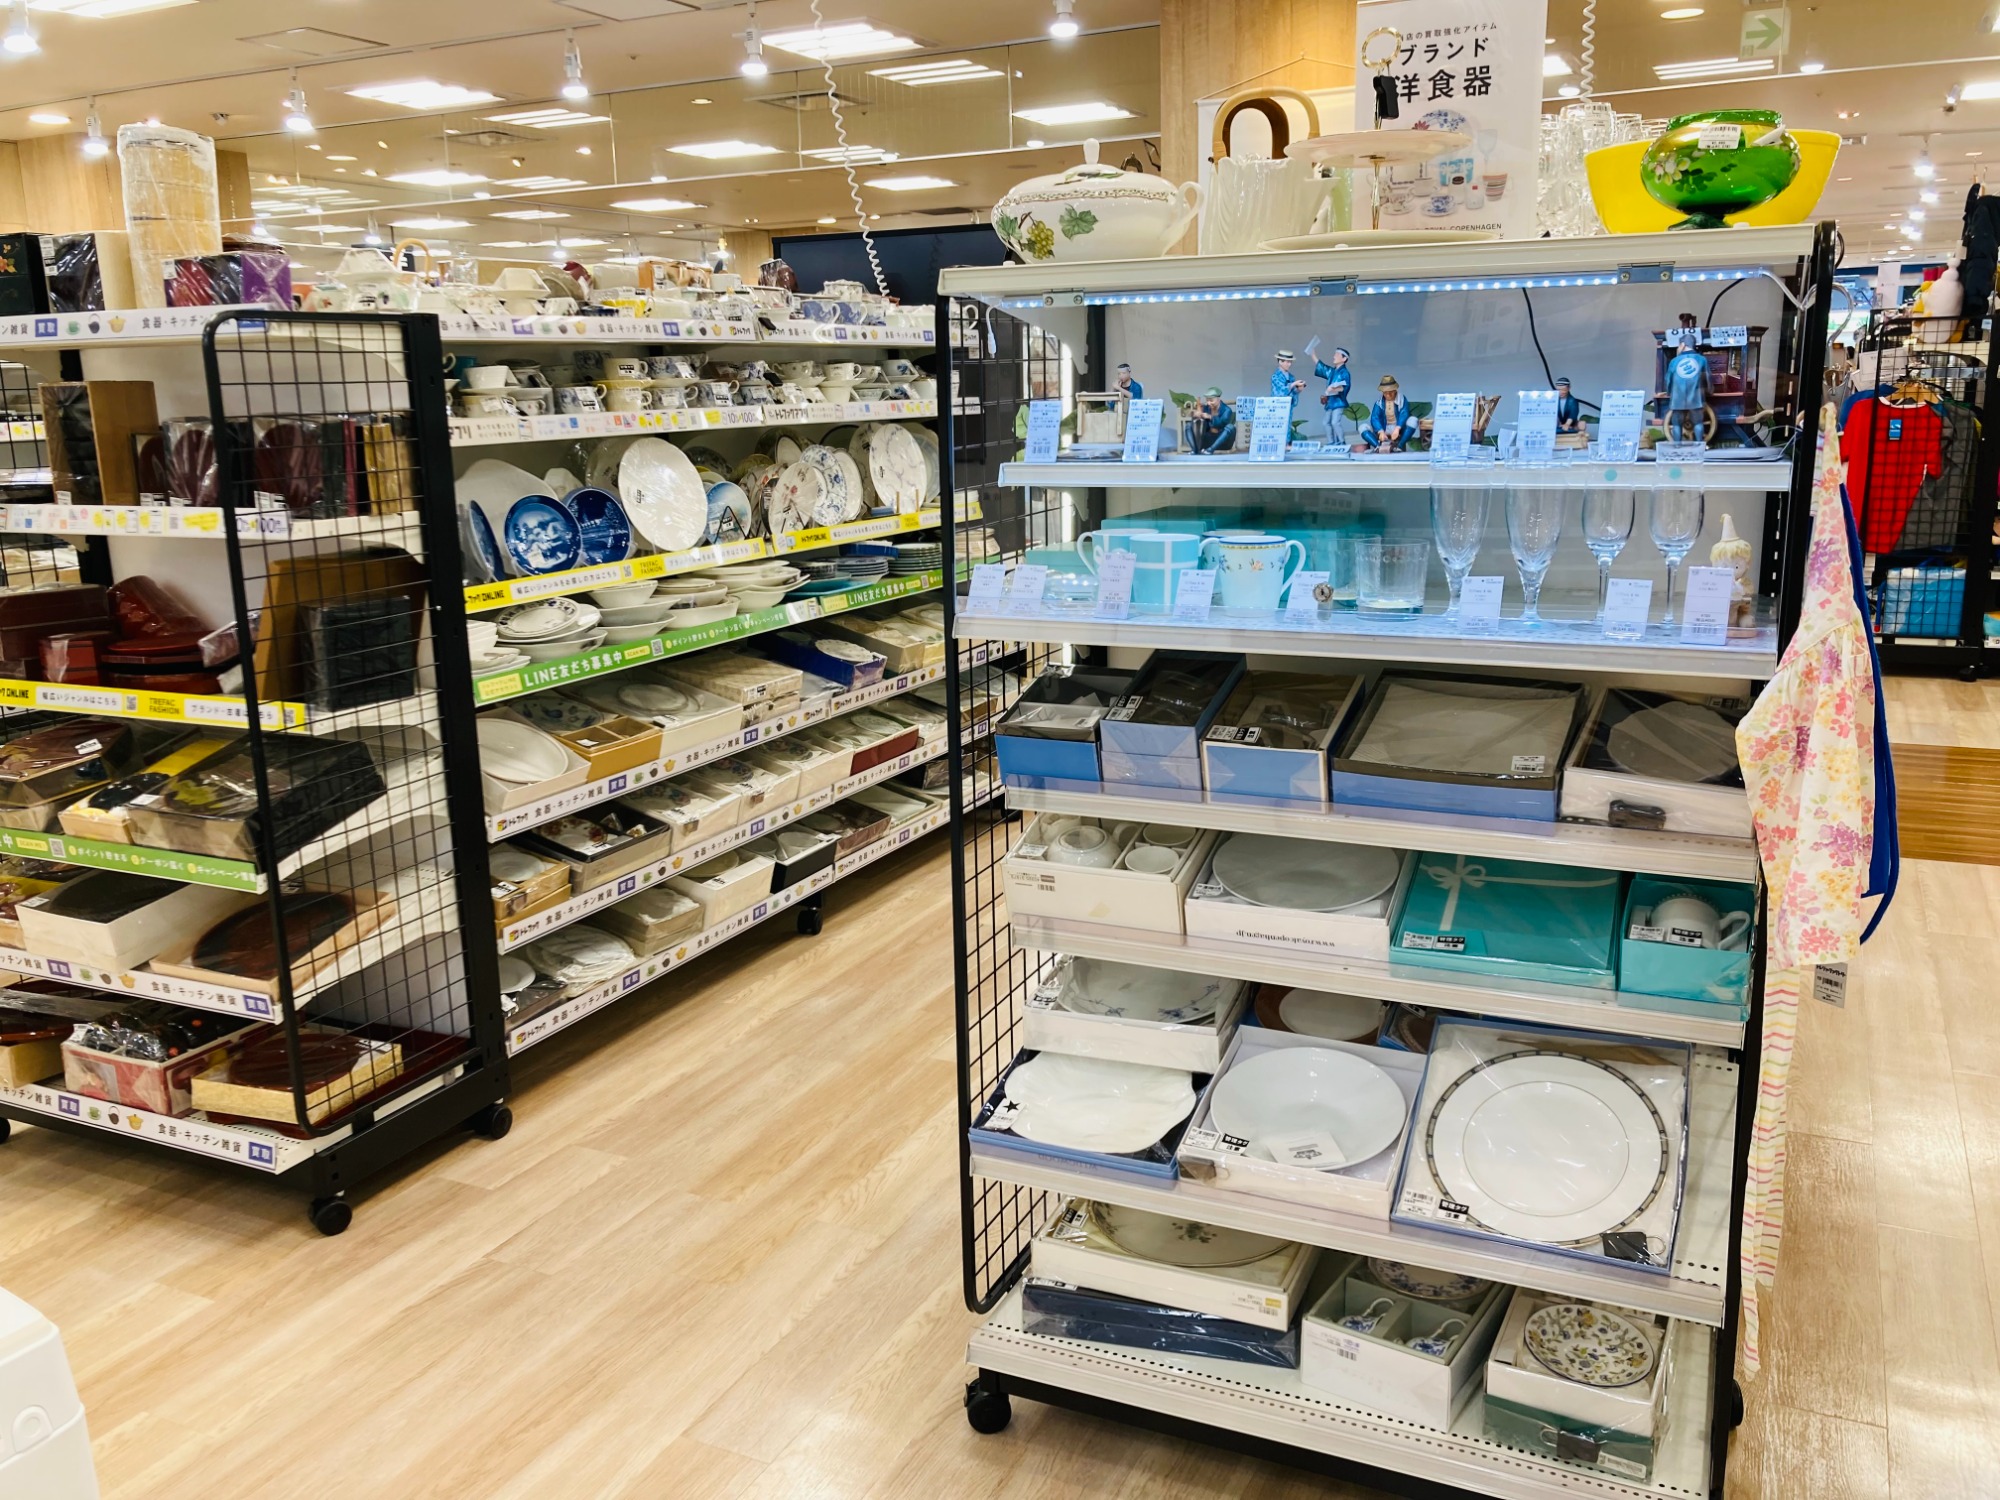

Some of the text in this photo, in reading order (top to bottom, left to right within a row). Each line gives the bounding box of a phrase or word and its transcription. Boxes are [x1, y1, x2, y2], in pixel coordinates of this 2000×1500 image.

[1400, 37, 1489, 66] ブランド
[1395, 64, 1493, 104] 洋食器
[1450, 223, 1502, 231] COPENHAGEN
[482, 589, 505, 603] ONLINE
[523, 650, 623, 688] LINE友だち募集中
[6, 689, 29, 699] ONLINE
[149, 697, 176, 707] TREFAC
[149, 705, 180, 715] FASHION
[534, 784, 604, 819] 食器・キッチン雑貨
[609, 775, 626, 793] 買取
[686, 736, 741, 764] 食器・キッチン雑貨
[545, 888, 614, 926] 食器・キッチン雑貨
[618, 877, 635, 894] 買取
[693, 828, 747, 860] 食器・キッチン雑貨
[551, 984, 619, 1026] 食器・キッチン雑貨
[697, 914, 750, 949] 食器・キッチン雑貨
[151, 981, 237, 1006] 食器・キッチン雑貨
[244, 997, 269, 1012] 買取
[60, 1098, 79, 1114] 買取
[158, 1123, 241, 1154] 食器・キッチン雑貨
[250, 1145, 271, 1160] 買取
